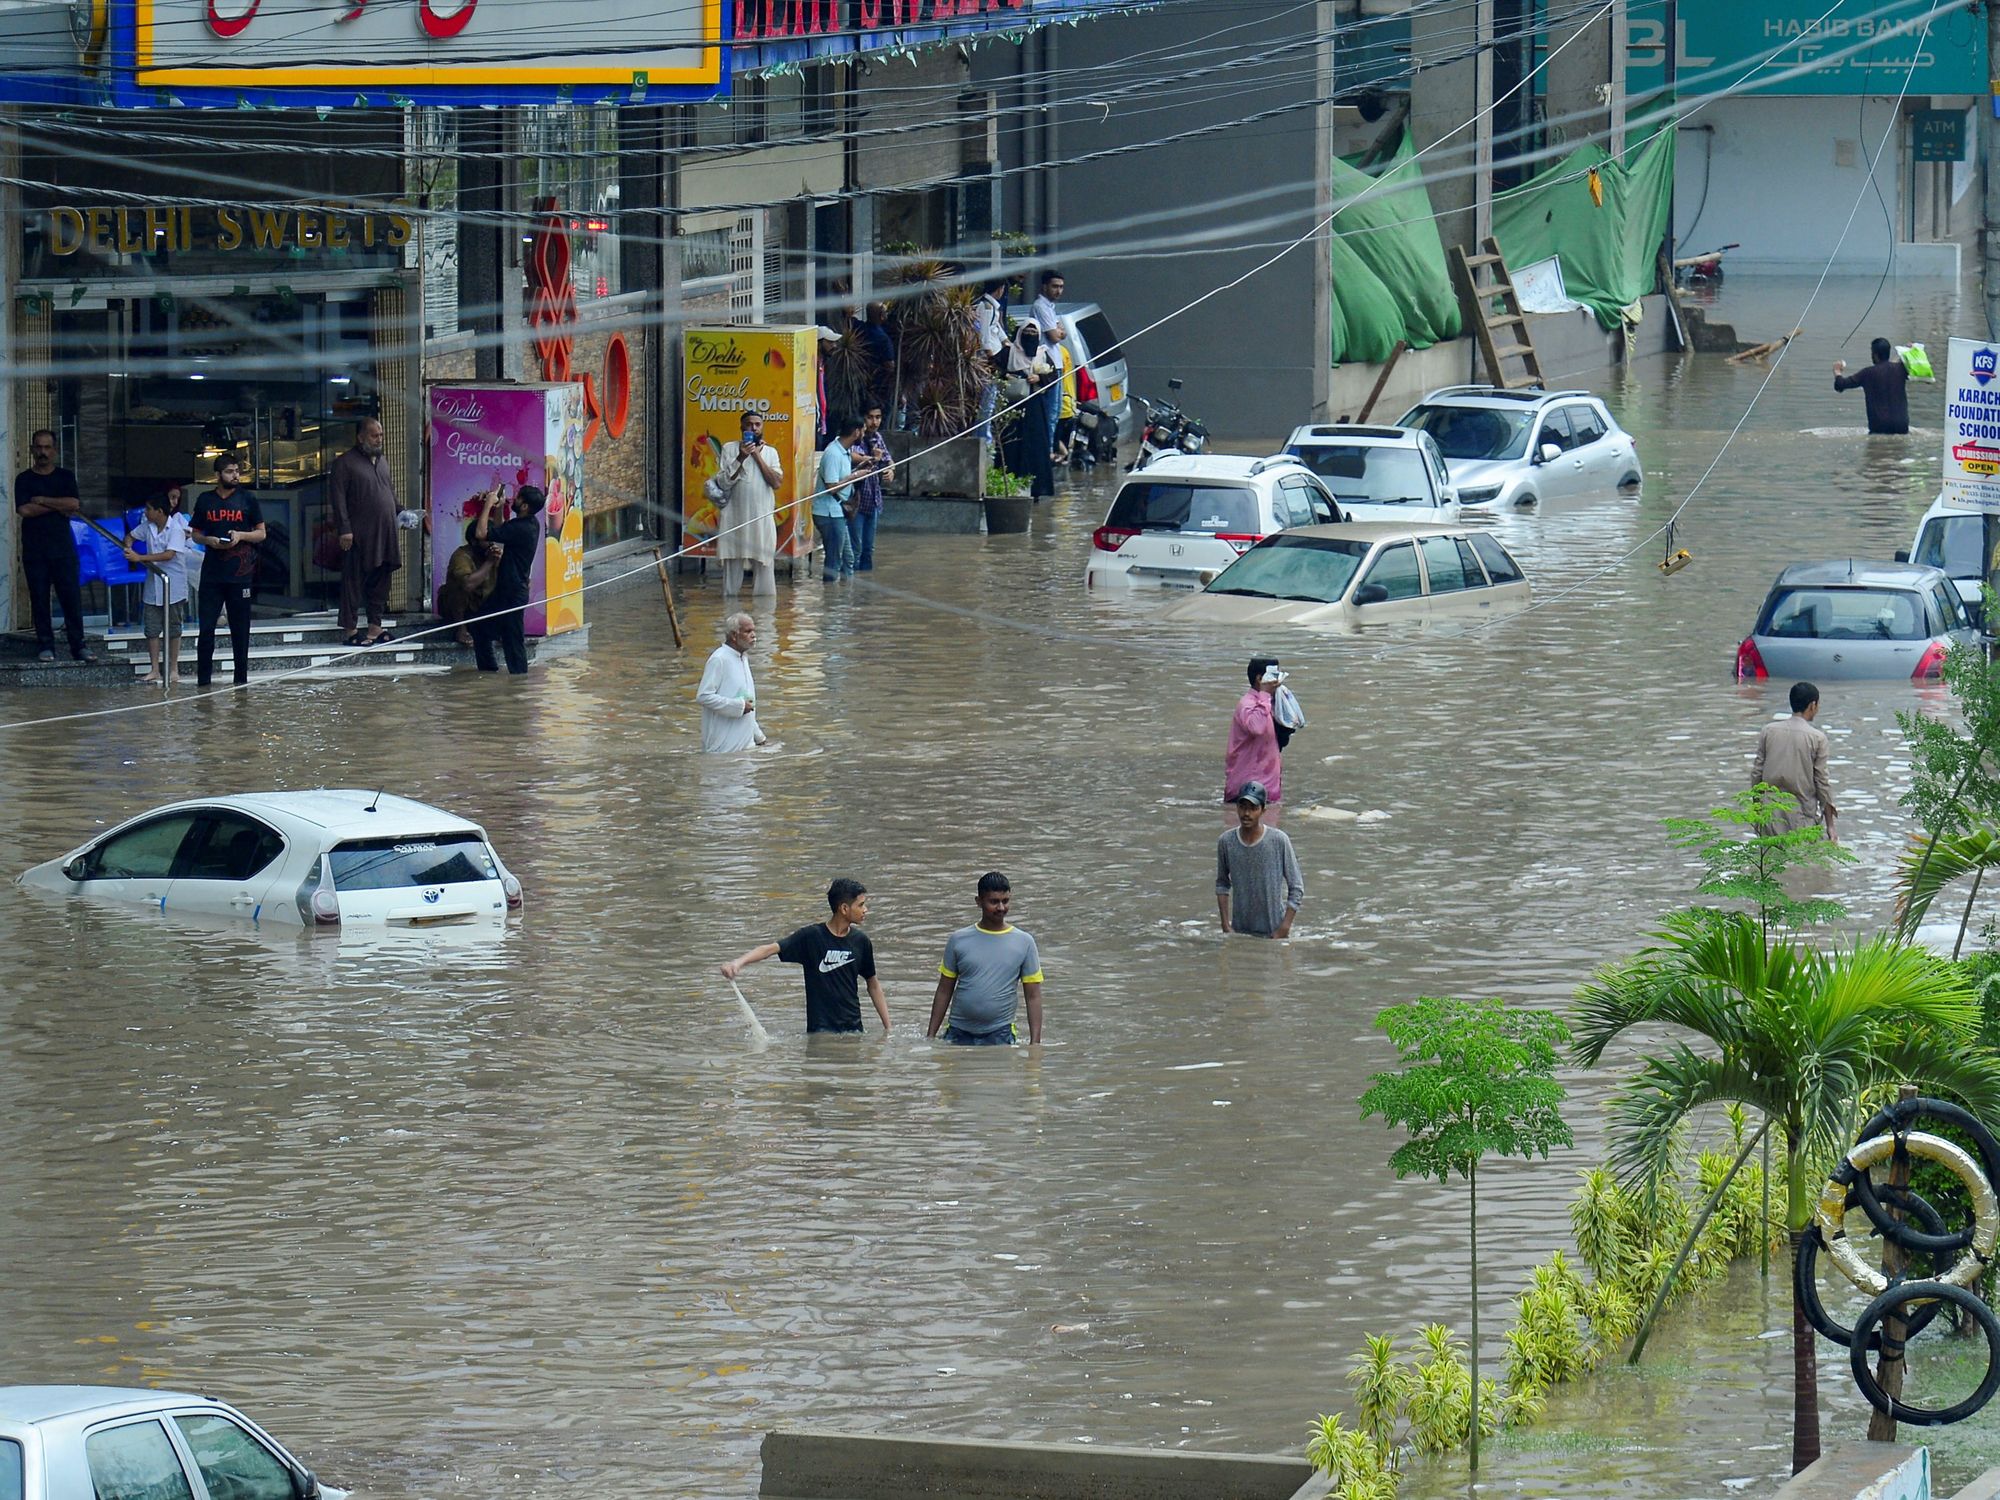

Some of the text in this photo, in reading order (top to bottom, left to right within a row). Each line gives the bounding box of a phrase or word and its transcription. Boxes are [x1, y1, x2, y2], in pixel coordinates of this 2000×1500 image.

[1764, 19, 1934, 37] HABIB BANK
[1923, 121, 1955, 134] ATM
[50, 198, 412, 255] DELHI SWEETS
[691, 339, 746, 364] Delhi
[1975, 355, 1993, 369] KFS
[687, 374, 750, 402] Special
[436, 396, 485, 417] Delhi
[700, 396, 771, 412] Mango
[446, 432, 504, 457] Special
[459, 453, 522, 466] Falooda
[1968, 462, 1994, 471] OPEN
[207, 510, 243, 521] ALPHA
[825, 950, 850, 962] NIKE
